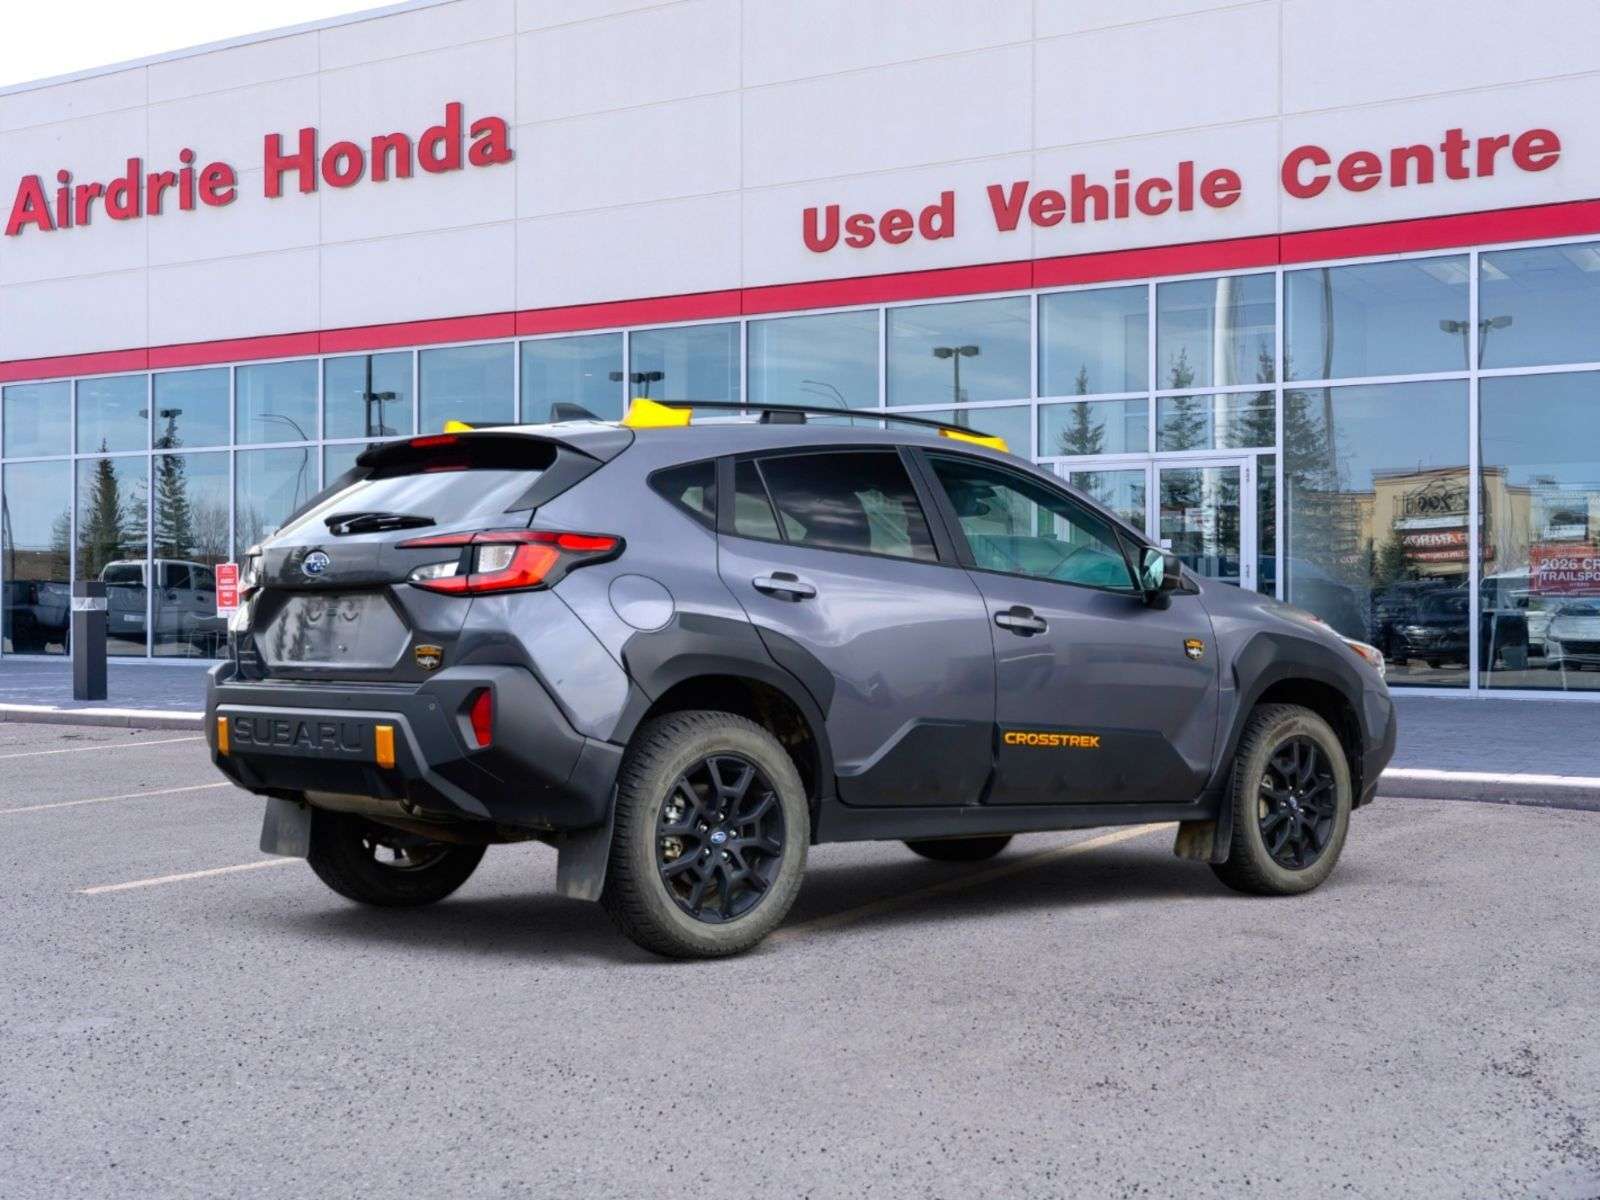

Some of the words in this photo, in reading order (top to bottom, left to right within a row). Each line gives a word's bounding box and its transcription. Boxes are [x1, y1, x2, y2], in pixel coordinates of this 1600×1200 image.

[6, 149, 235, 236] Airdrie
[264, 102, 513, 198] Honda
[803, 192, 955, 253] Used
[987, 161, 1242, 232] Vehicle
[1281, 128, 1561, 200] Centre
[1541, 558, 1578, 570] 2026
[233, 716, 366, 752] SUBARU
[1004, 732, 1099, 748] CROSSTREK
